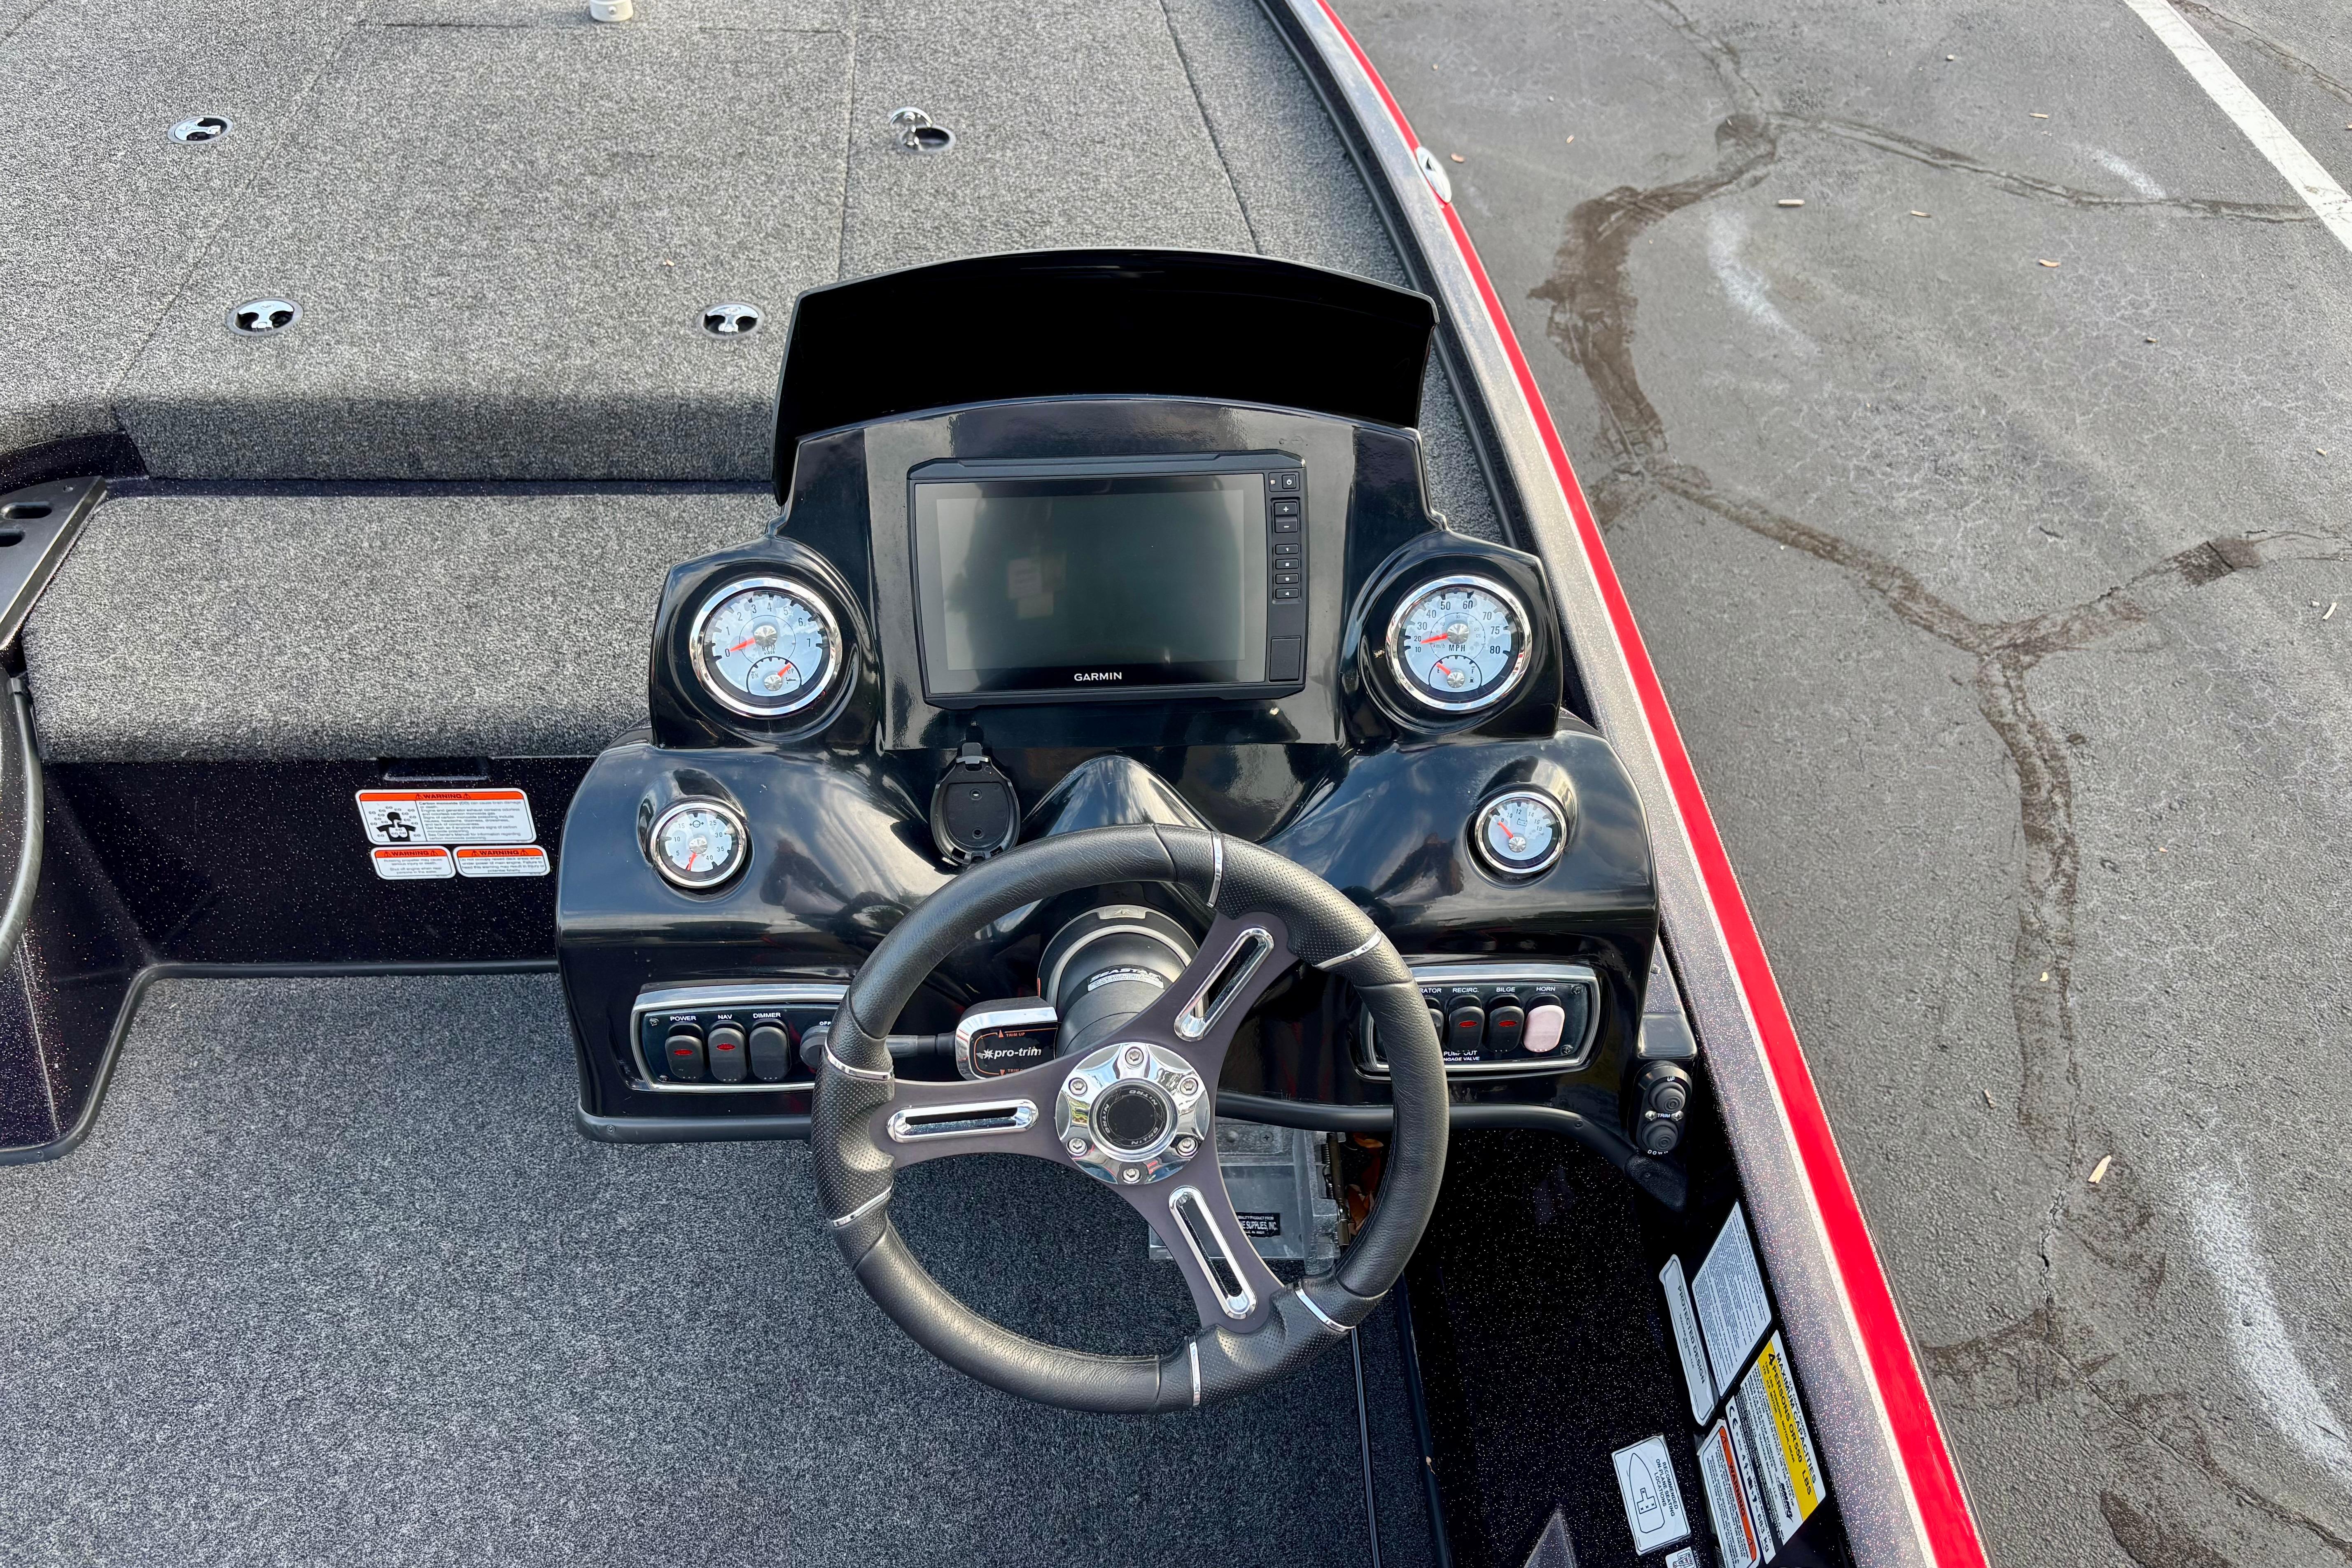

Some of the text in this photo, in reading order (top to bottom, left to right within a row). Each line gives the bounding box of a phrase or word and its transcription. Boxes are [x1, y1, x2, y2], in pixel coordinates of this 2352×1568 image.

[751, 604, 756, 614] 3
[767, 603, 772, 612] 4
[1441, 602, 1451, 610] 50
[1463, 600, 1473, 609] 60
[784, 606, 789, 616] 5
[1426, 610, 1436, 618] 40
[1483, 611, 1491, 620] 70
[737, 612, 743, 621] 2
[798, 618, 803, 626] 6
[1417, 622, 1427, 630] 30
[726, 627, 730, 635] 1
[1491, 626, 1500, 635] 75
[807, 638, 811, 647] 7
[725, 649, 730, 657] 0
[1490, 646, 1500, 654] 80
[1074, 672, 1122, 682] GARMIN
[994, 1047, 1041, 1059] pro-trim
[1677, 1284, 1705, 1385] PROTECTED DESIGN
[1727, 1404, 1738, 1430] CE
[1767, 1347, 1812, 1496] 4 PERSONS OR 550 LBS
[1776, 1351, 1817, 1484] MAXIMUM CAPACITIES
[1654, 1472, 1667, 1507] LOCATIONS
[1655, 1458, 1675, 1517] ON-PLANE SEATING
[1661, 1461, 1679, 1510] RECOMMENDED
[1728, 1461, 1746, 1517] WARNING
[1741, 1452, 1746, 1461] 4
[1762, 1536, 1770, 1553] kg
